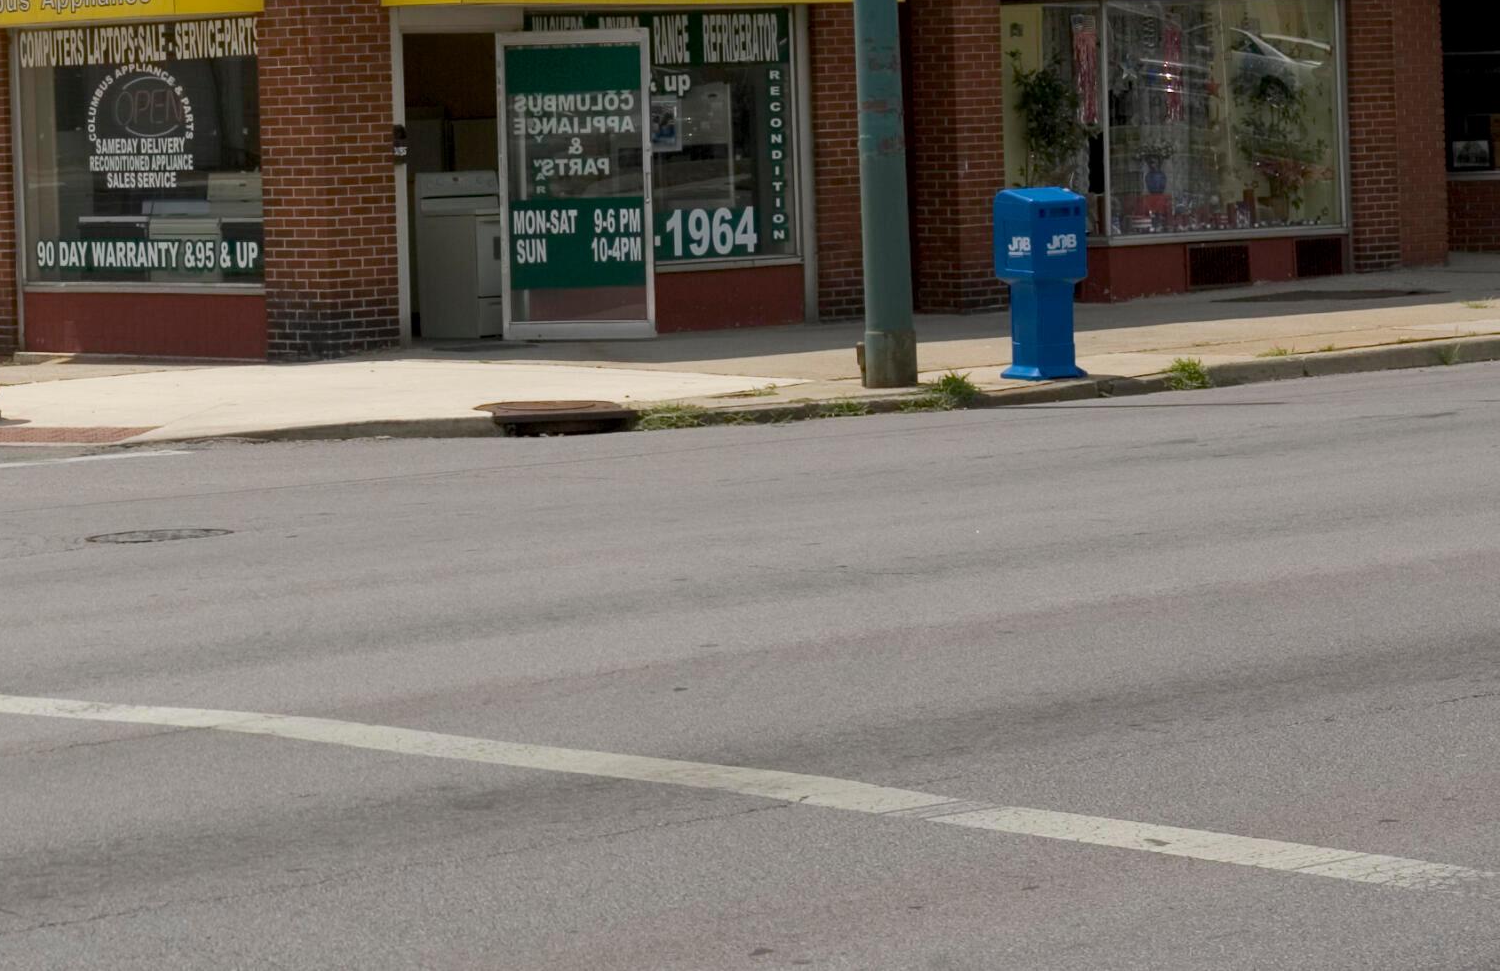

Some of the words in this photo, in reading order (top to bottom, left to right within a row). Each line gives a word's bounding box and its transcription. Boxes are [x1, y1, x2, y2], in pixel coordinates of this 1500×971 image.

[19, 27, 85, 68] COMPUTERS
[653, 15, 690, 64] RANGE
[702, 13, 780, 62] REFRIGERATOR
[664, 74, 691, 96] up
[87, 75, 113, 142] COLUMBUS
[114, 63, 175, 86] APPLIANCE
[174, 86, 183, 96] &
[181, 97, 194, 140] PARTS
[115, 89, 184, 126] OPEN
[96, 138, 139, 154] SAMEDAY
[141, 137, 185, 154] DELIVERY
[769, 70, 785, 240] RECONDITION
[89, 155, 149, 172] RECONDITIONED
[151, 154, 194, 170] APPLIANCE
[107, 172, 136, 188] SALES
[137, 171, 177, 188] SERVICE
[513, 209, 578, 235] MON-SAT
[593, 209, 616, 231] 9-6
[620, 208, 642, 233] PM
[37, 241, 55, 267] 90
[59, 241, 88, 267] DAY
[91, 241, 179, 268] WARRANTY
[219, 241, 231, 268] &
[236, 242, 258, 268] UP
[516, 238, 547, 263] SUN
[591, 236, 642, 262] 10-4PM
